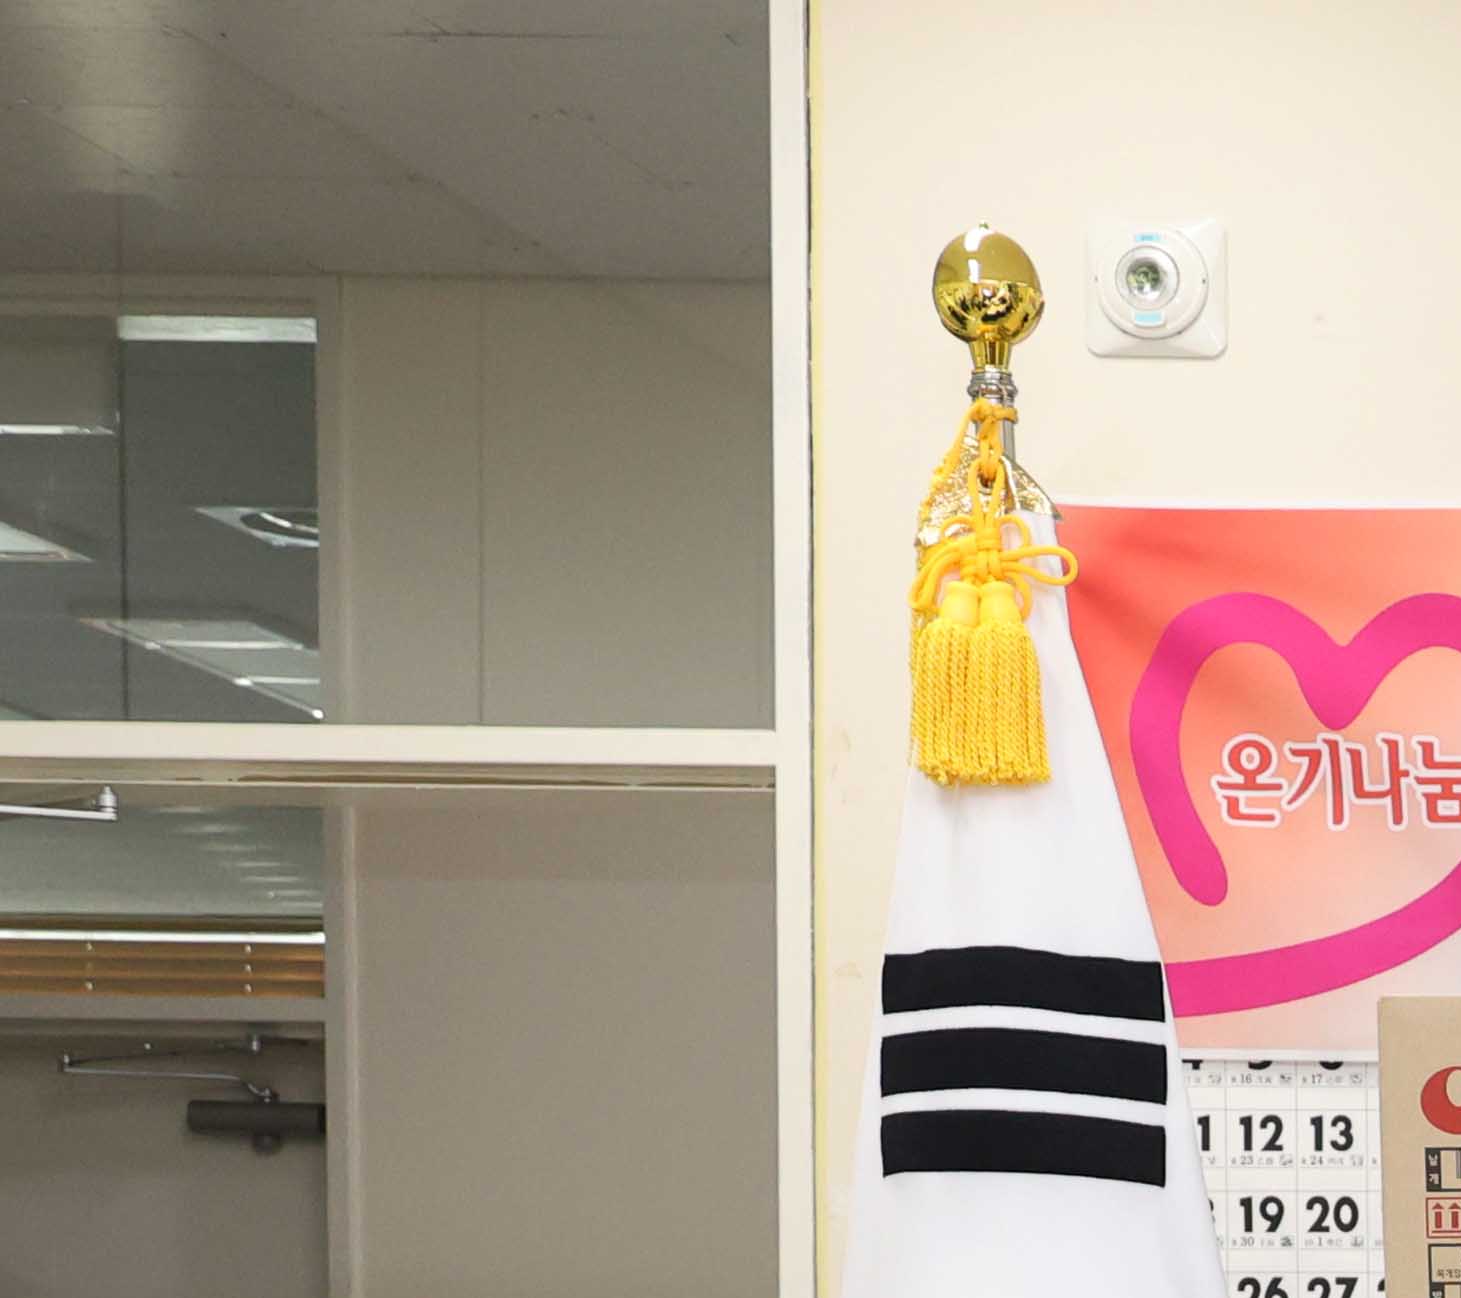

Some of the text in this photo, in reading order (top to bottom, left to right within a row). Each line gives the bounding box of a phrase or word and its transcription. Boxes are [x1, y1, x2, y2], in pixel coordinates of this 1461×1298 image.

[1239, 1115, 1284, 1151] 12
[1310, 1115, 1354, 1151] 13
[1239, 1196, 1285, 1233] 19
[1305, 1196, 1359, 1233] 20
